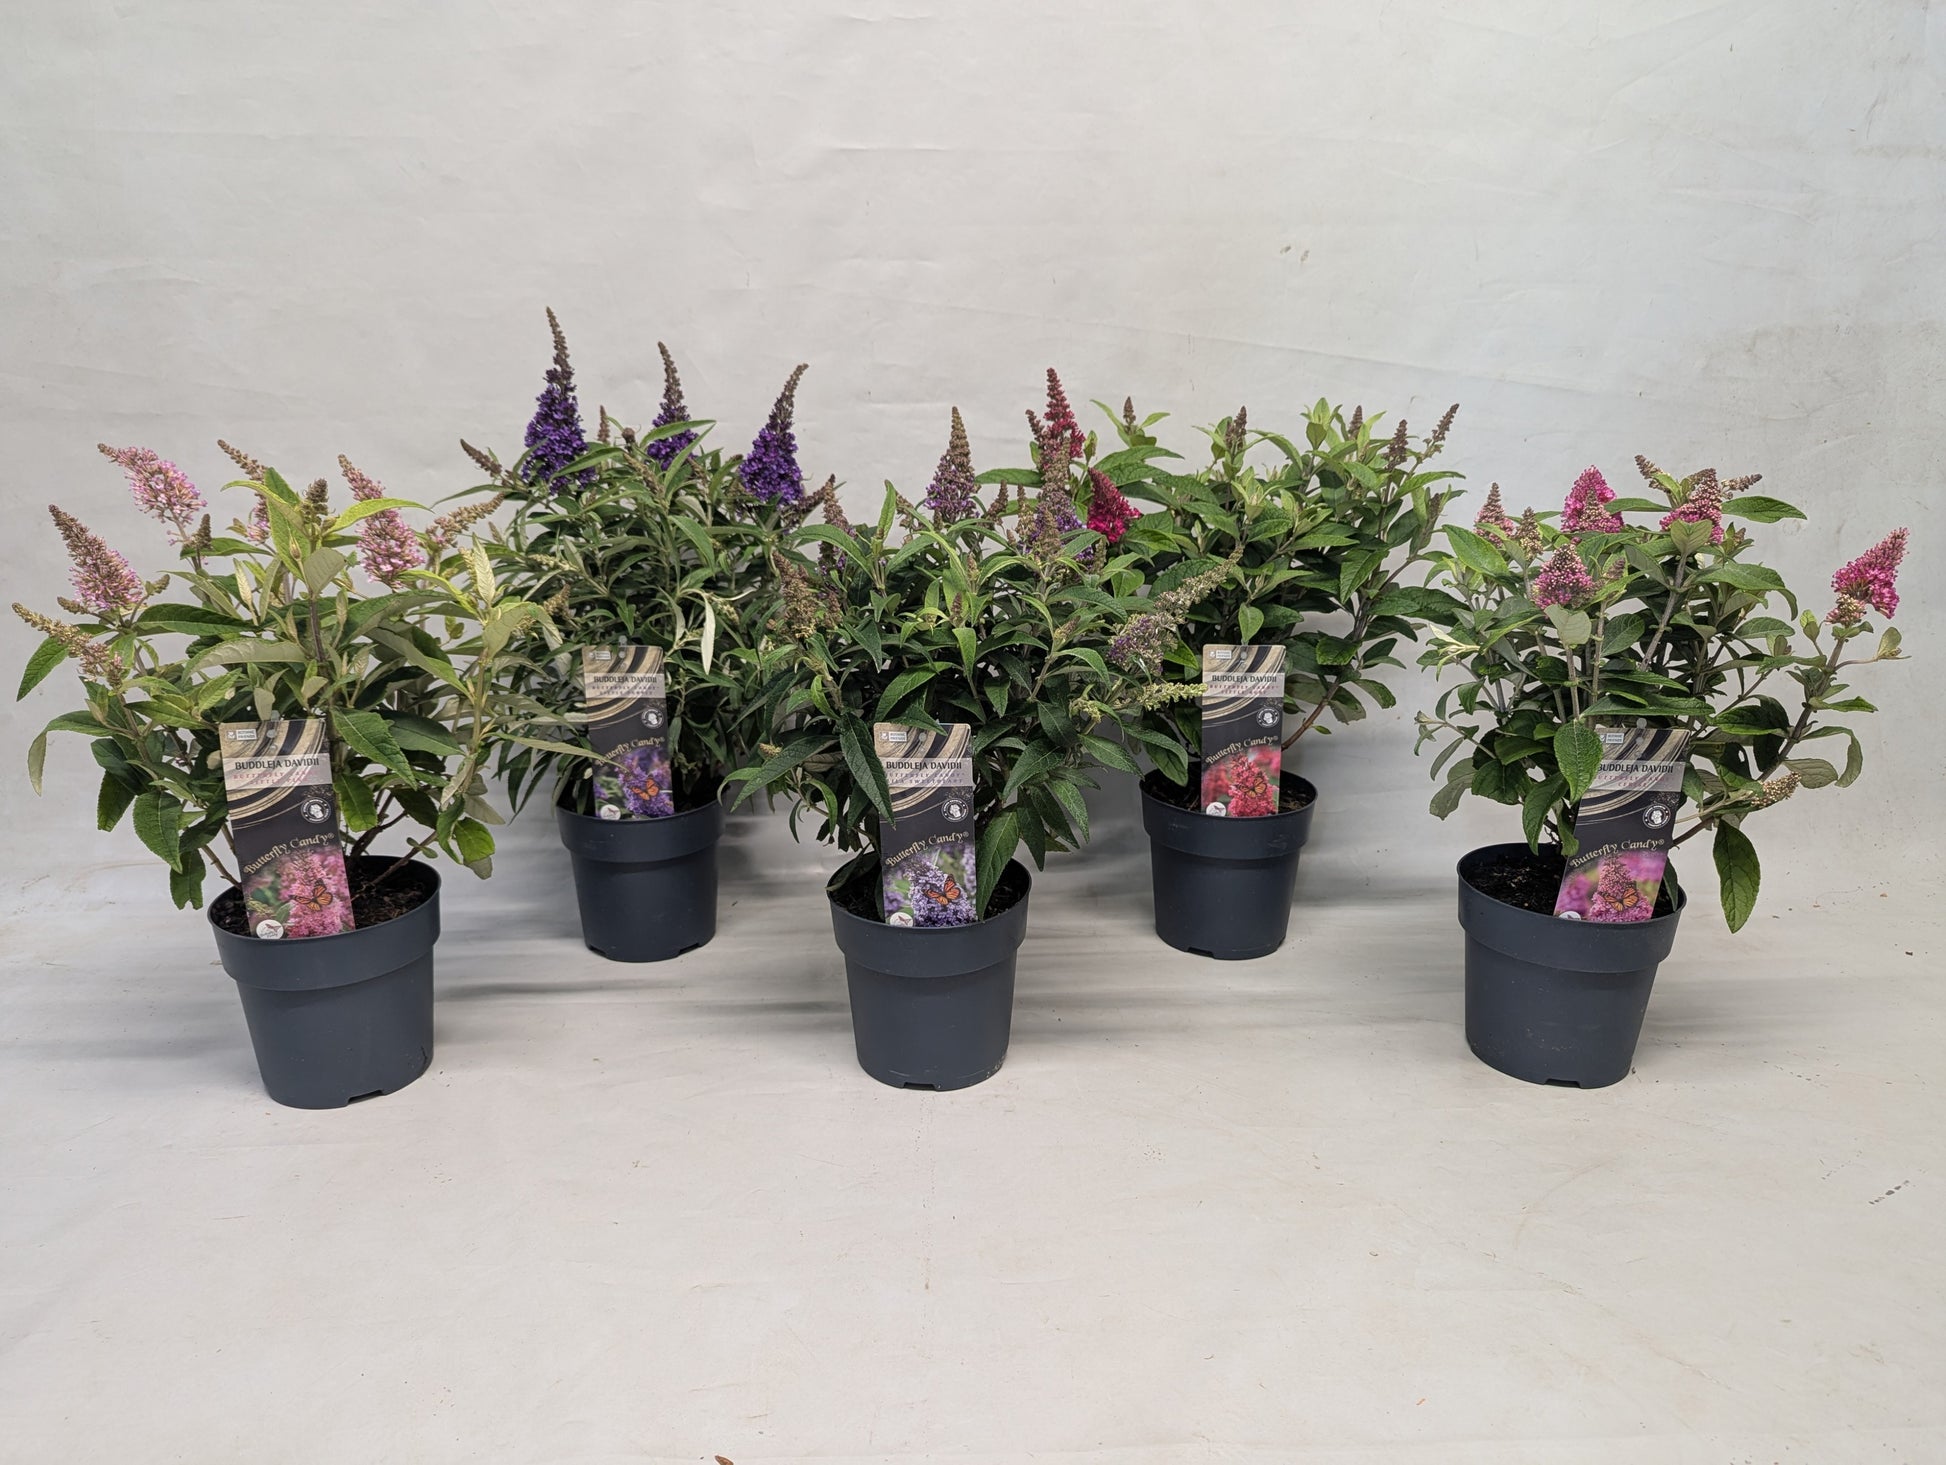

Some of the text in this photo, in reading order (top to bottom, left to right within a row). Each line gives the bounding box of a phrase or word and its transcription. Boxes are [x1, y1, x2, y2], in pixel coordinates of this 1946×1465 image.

[1212, 675, 1247, 683] BUDDLEJA
[1205, 742, 1243, 764] Butterfly
[235, 758, 320, 770] BUDDLEJA DAVIDII
[886, 762, 928, 770] BUDDLEJA
[1599, 763, 1674, 773] BUDDLEJA DAVIDII
[243, 843, 291, 874] Butterfly
[885, 840, 928, 866] Butterfly
[1570, 844, 1618, 868] Butterfly
